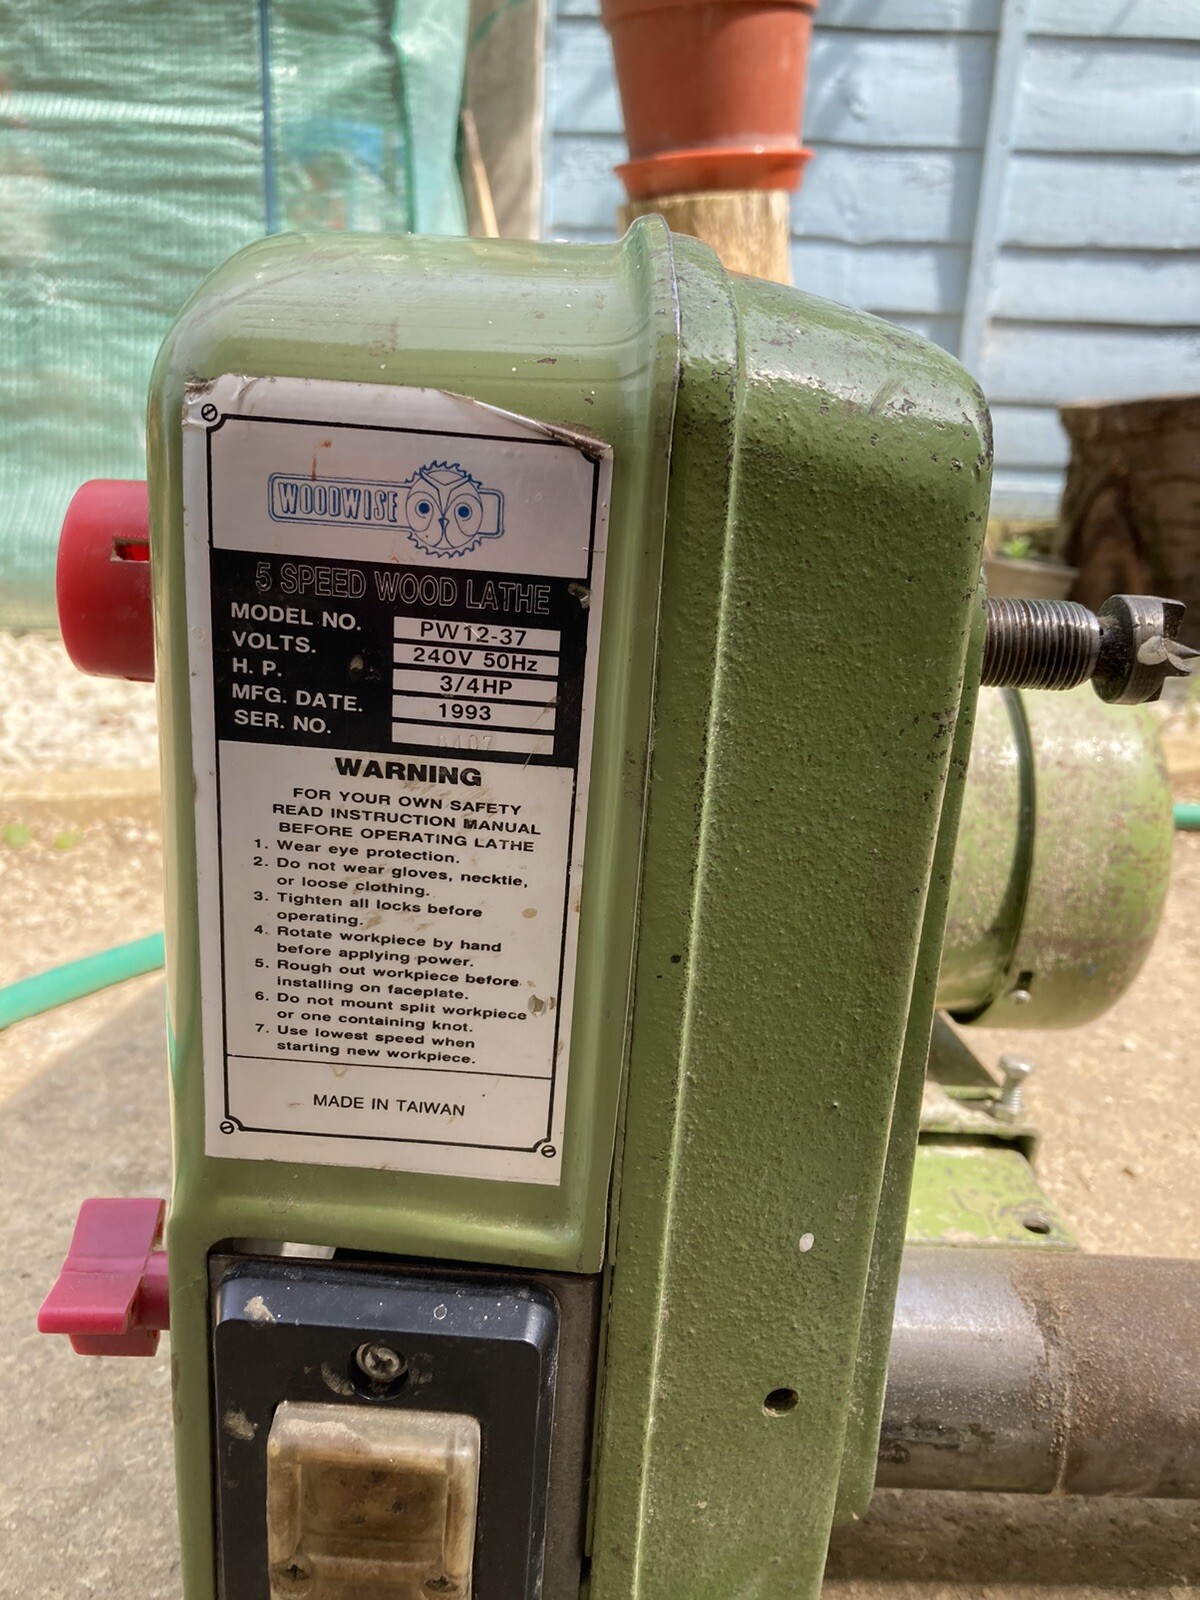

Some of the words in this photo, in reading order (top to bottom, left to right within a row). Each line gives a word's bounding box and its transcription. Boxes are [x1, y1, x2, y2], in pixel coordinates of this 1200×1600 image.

[278, 483, 398, 522] WOODWISE
[255, 561, 272, 591] 5
[281, 564, 366, 599] SPEED
[374, 572, 457, 607] WOOD
[466, 581, 551, 614] LATHE
[232, 602, 313, 625] MODEL
[323, 612, 361, 630] NO.
[232, 631, 316, 653] VOLTS.
[421, 621, 526, 646] PW12-37
[233, 657, 253, 674] H.
[263, 660, 281, 676] P.
[414, 647, 472, 665] 240V
[484, 653, 537, 671] 50Hz
[440, 675, 512, 695] 3/4HP
[233, 683, 287, 703] MFG.
[296, 690, 362, 712] DATE.
[235, 710, 284, 728] SER.
[294, 716, 331, 733] NO.
[439, 703, 491, 720] 1993
[335, 757, 481, 786] WARNING
[294, 788, 330, 800] FOR
[339, 792, 390, 805] YOUR
[399, 796, 442, 809] OWN
[450, 801, 521, 815] SAFETY
[273, 804, 323, 817] READ
[330, 807, 456, 828] INSTRUCTION
[464, 819, 541, 835] MANUAL
[279, 822, 352, 837] BEFORE
[361, 829, 467, 846] OPERATING
[475, 838, 534, 852] LATHE
[255, 839, 268, 849] 1.
[277, 840, 321, 852] Wear
[329, 846, 358, 857] eye
[367, 849, 459, 863] protection.
[254, 856, 268, 866] 2.
[277, 858, 300, 868] Do
[309, 862, 335, 871] not
[344, 865, 384, 874] wear
[392, 867, 452, 882] gloves,
[461, 874, 527, 888] necktie,
[303, 877, 348, 889] loose
[356, 881, 429, 897] clothing.
[254, 891, 268, 901] 3.
[277, 892, 342, 906] Tighten
[350, 898, 368, 908] all
[377, 900, 421, 912] locks
[428, 904, 482, 917] before
[277, 912, 363, 927] operating.
[254, 925, 268, 935] 4.
[278, 926, 332, 939] Rotate
[340, 933, 425, 946] workpiece
[434, 938, 453, 950] by
[461, 940, 501, 952] hand
[277, 943, 331, 956] before
[339, 950, 409, 964] applying
[418, 954, 473, 966] power.
[255, 958, 268, 968] 5.
[278, 960, 331, 974] Rough
[339, 967, 365, 975] out
[373, 969, 459, 982] workpiece
[466, 974, 519, 986] before
[278, 976, 353, 993] installing
[388, 985, 468, 999] faceplate.
[255, 991, 269, 1000] 6.
[278, 993, 299, 1003] Do
[307, 997, 333, 1005] not
[341, 1000, 392, 1010] mount
[400, 1003, 435, 1014] split
[443, 1007, 526, 1020] workpiece
[301, 1013, 331, 1021] one
[339, 1016, 425, 1030] containing
[433, 1020, 472, 1032] knot.
[256, 1024, 269, 1033] 7.
[278, 1025, 307, 1036] Use
[316, 1028, 368, 1040] lowest
[375, 1034, 424, 1044] speed
[432, 1037, 474, 1048] when
[277, 1042, 339, 1056] starting
[347, 1048, 380, 1056] new
[387, 1049, 475, 1063] workpiece.
[314, 1094, 364, 1109] MADE
[372, 1099, 388, 1110] IN
[396, 1100, 464, 1116] TAIWAN
